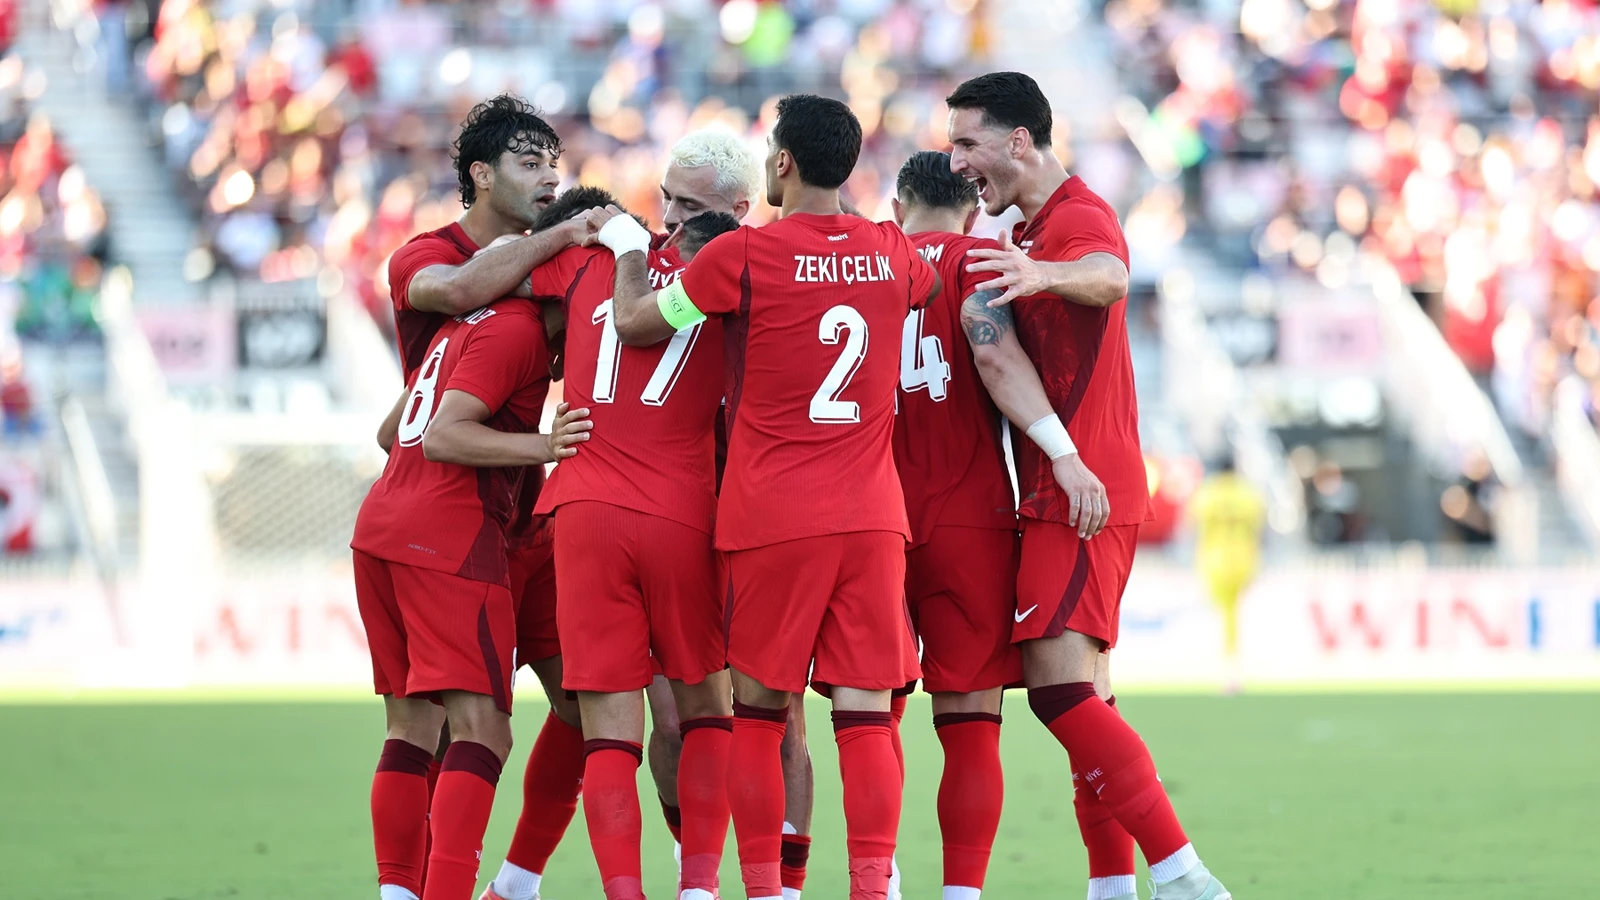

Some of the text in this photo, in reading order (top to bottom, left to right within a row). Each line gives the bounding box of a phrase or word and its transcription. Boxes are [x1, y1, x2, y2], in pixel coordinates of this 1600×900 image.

[794, 251, 895, 286] ZEKİ ÇELİK
[398, 337, 449, 448] 8
[592, 298, 707, 406] 17
[809, 305, 869, 423] 2
[893, 308, 951, 416] 4
